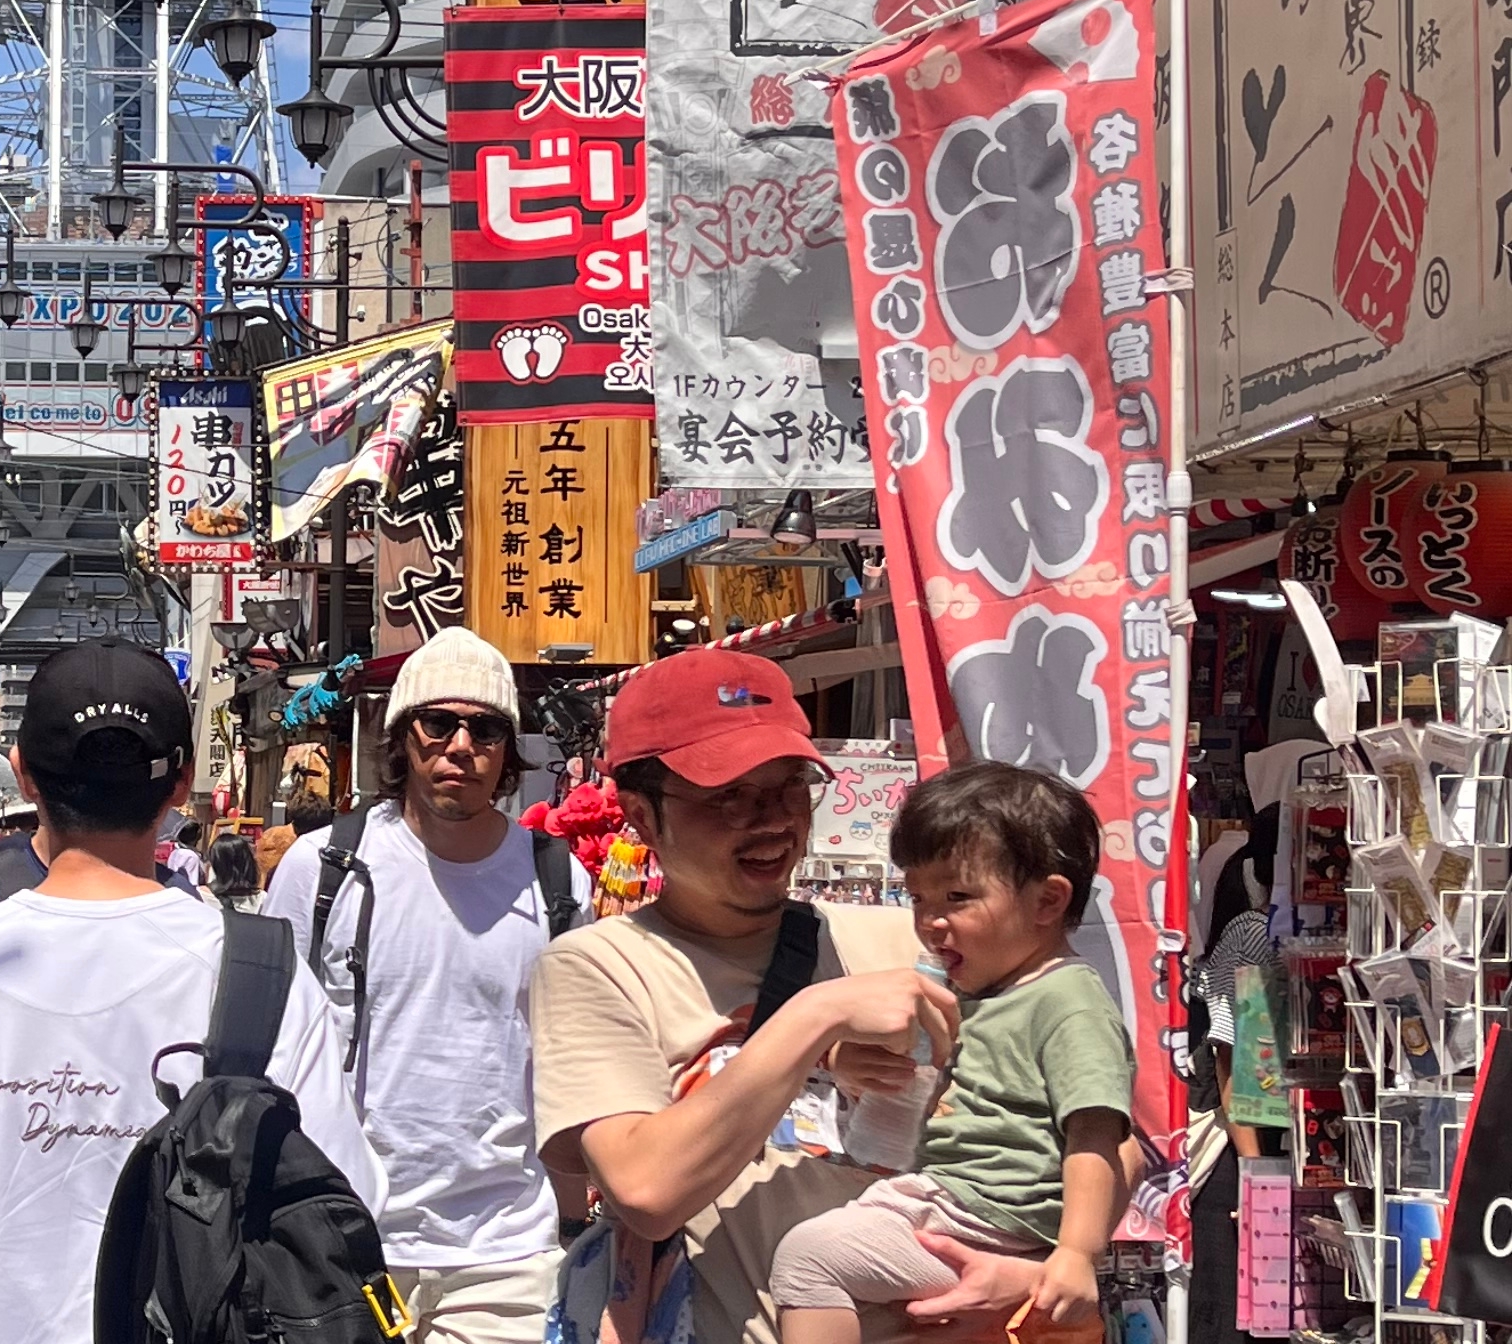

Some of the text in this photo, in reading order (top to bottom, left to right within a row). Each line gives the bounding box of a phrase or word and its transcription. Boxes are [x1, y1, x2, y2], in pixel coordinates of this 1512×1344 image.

[519, 57, 640, 118] 大阪
[1216, 246, 1237, 423] 総本店
[84, 405, 101, 420] to
[179, 386, 228, 404] Asahi
[672, 375, 826, 399] 1Fカウンター
[191, 411, 236, 508] 串カツ
[499, 470, 531, 619] 元祖新世界
[538, 422, 587, 620] 五年創業
[1361, 466, 1419, 589] ソースの
[1421, 482, 1483, 609] いっとく
[73, 702, 149, 725] DRY ALLS
